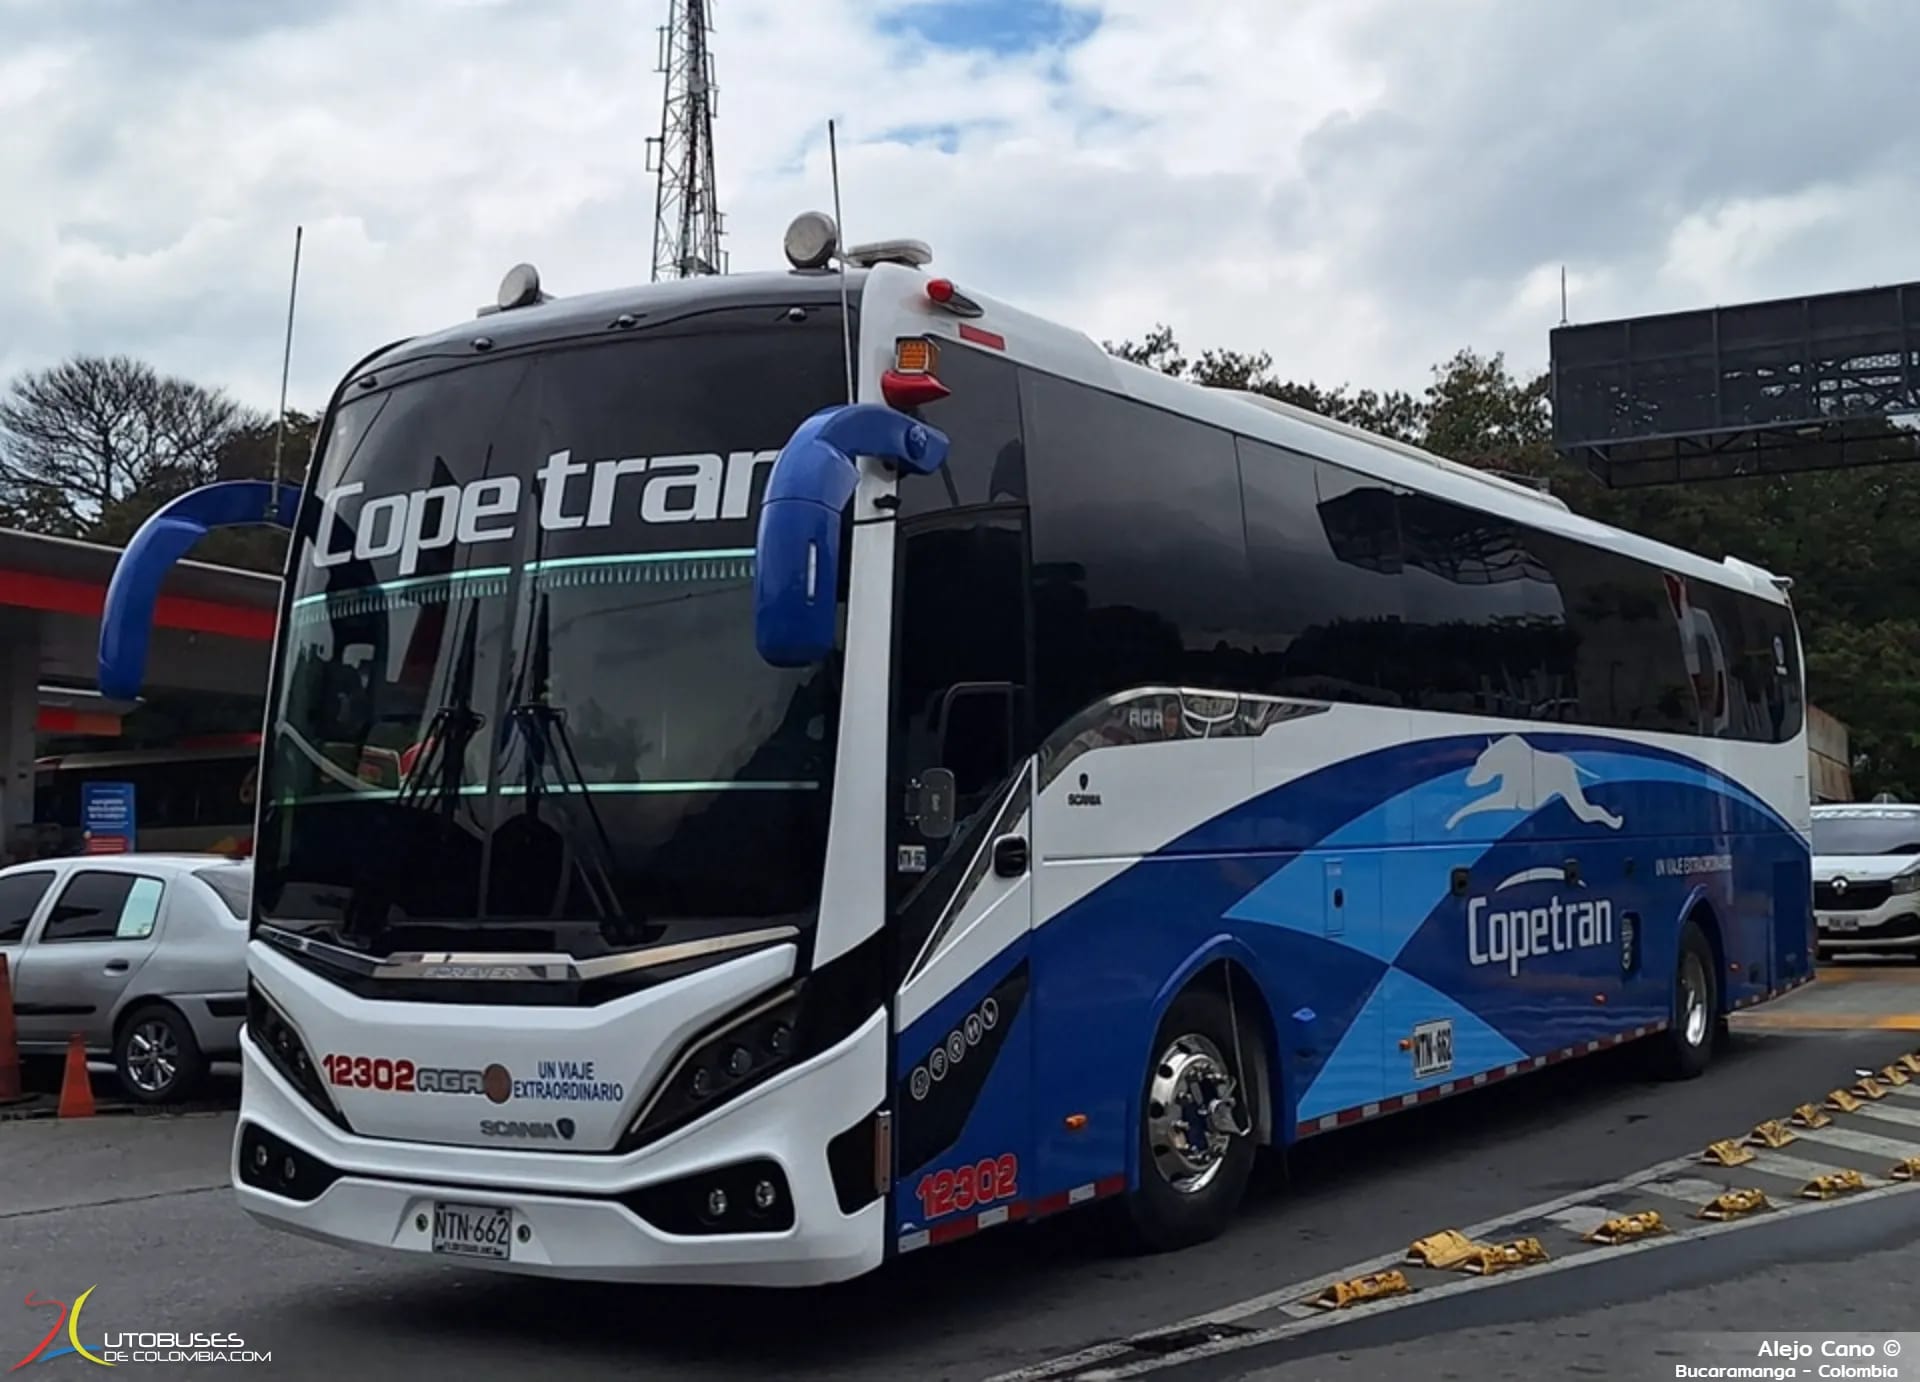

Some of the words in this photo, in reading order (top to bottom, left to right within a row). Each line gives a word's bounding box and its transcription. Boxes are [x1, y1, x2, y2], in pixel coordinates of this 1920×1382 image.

[1468, 895, 1613, 977] Copetran
[322, 1054, 416, 1092] 12302
[538, 1062, 556, 1079] UN
[560, 1062, 595, 1080] VIAJE
[513, 1081, 624, 1102] EXTRAORDINARIO
[479, 1119, 559, 1139] SCANIA
[916, 1153, 1018, 1220] 12302
[435, 1212, 509, 1245] NTN-662
